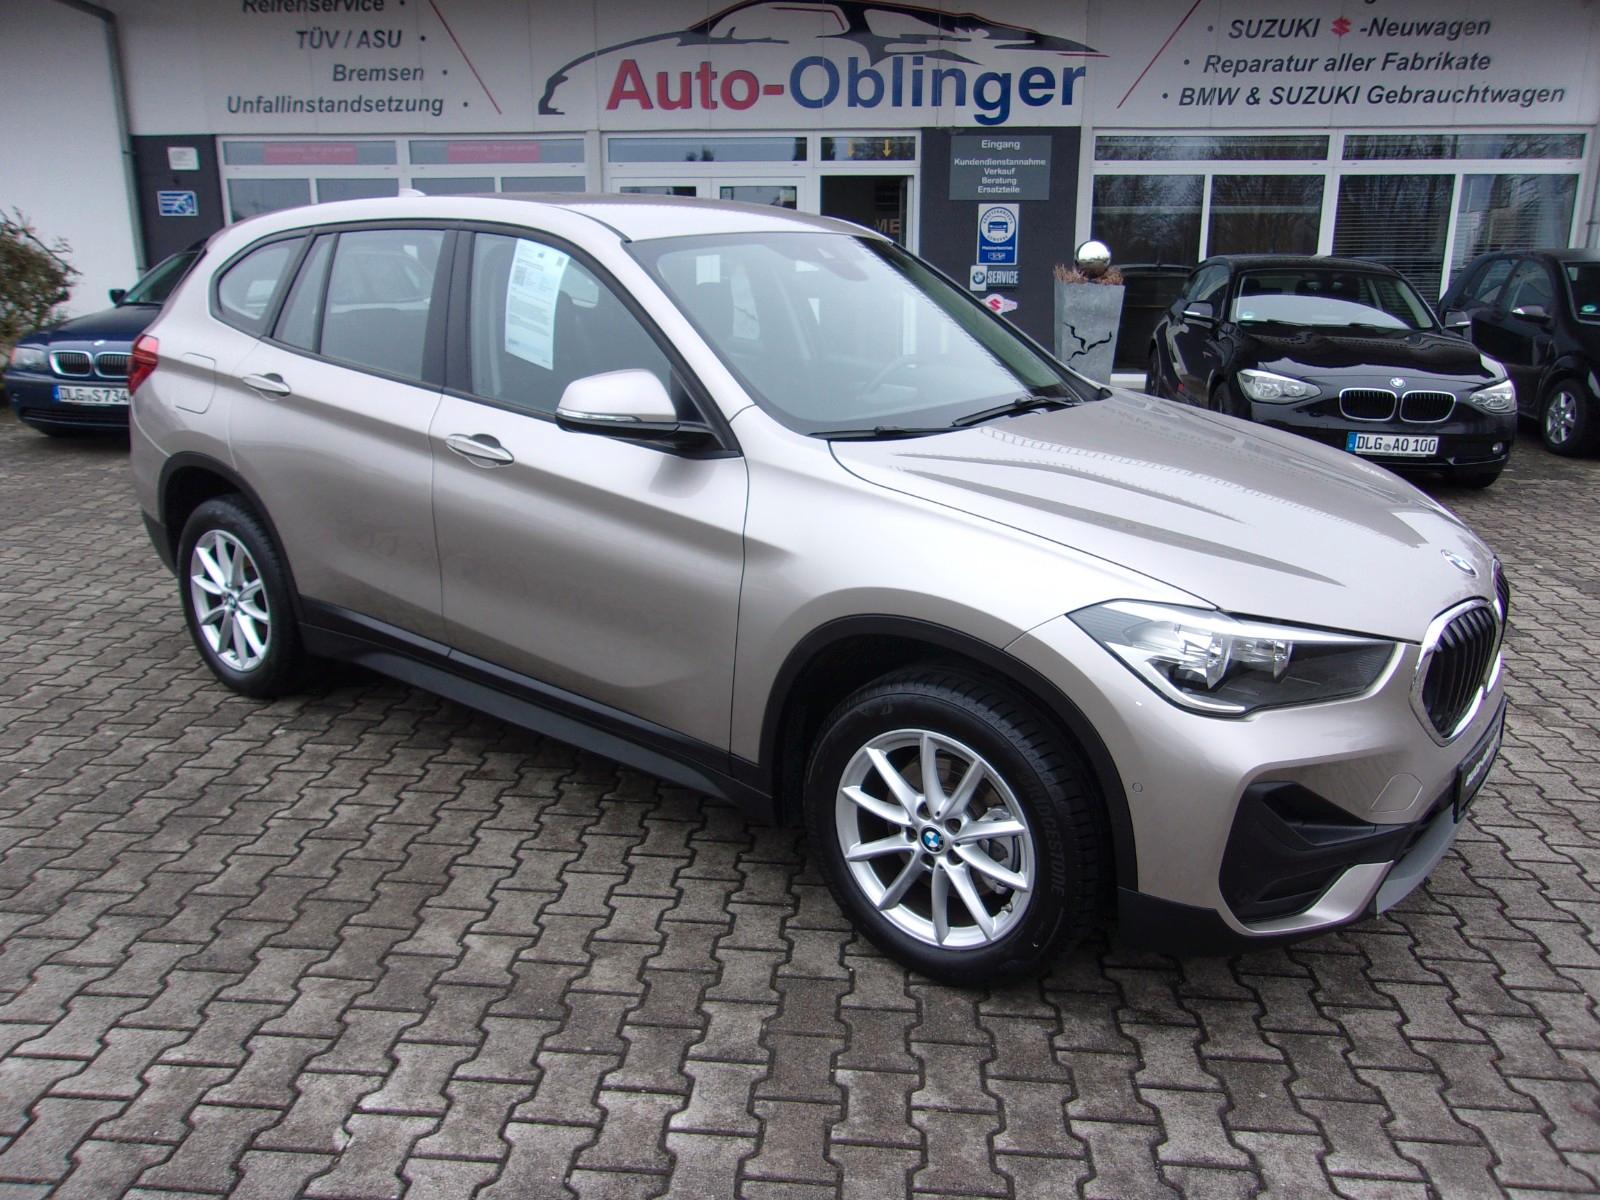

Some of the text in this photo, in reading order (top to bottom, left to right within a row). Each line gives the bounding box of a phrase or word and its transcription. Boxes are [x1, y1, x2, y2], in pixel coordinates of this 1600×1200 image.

[242, 0, 385, 13] Reifenservice
[1228, 17, 1492, 41] SUZUKI -Neuwagen
[296, 27, 340, 48] TÜV
[357, 30, 402, 48] ASU
[332, 64, 424, 82] Bremsen
[1203, 52, 1492, 78] Reparatur aller Fabrikate
[605, 55, 1086, 126] Auto-Oblinger
[1178, 84, 1566, 108] BMW & SUZUKI Gebrauchtwagen
[227, 96, 444, 116] Unfallinstandsetzung
[981, 139, 1021, 151] Eingang
[953, 158, 1046, 166] Kundendienstannahme
[983, 167, 1016, 175] Verkauf
[977, 185, 1020, 193] Ersatzteile
[981, 177, 1017, 185] Beratung
[987, 270, 1018, 284] SERVICE
[1356, 436, 1437, 452] DLG AO 100
